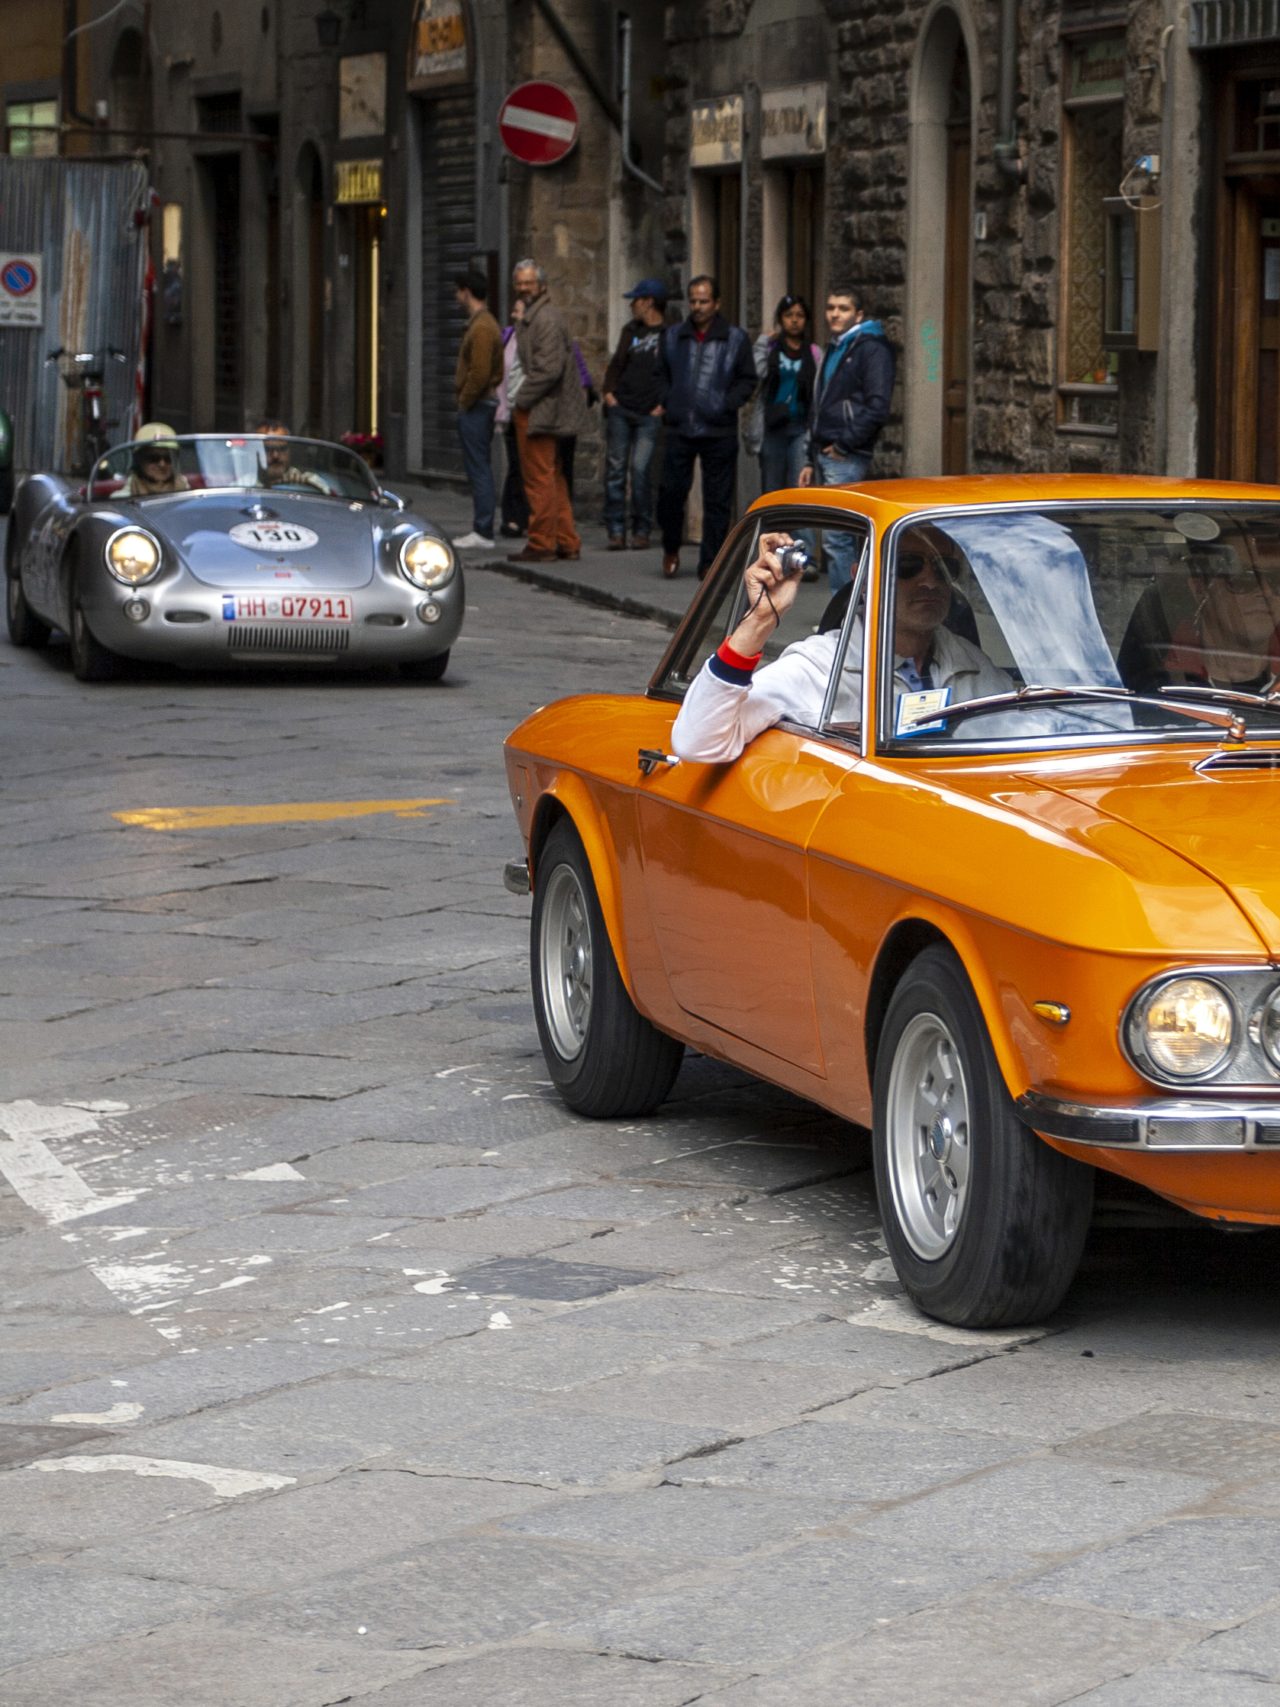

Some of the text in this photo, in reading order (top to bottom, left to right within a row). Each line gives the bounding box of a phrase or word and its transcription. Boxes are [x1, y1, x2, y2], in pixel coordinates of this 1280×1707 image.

[247, 530, 302, 542] 130
[238, 597, 348, 618] HH 07911
